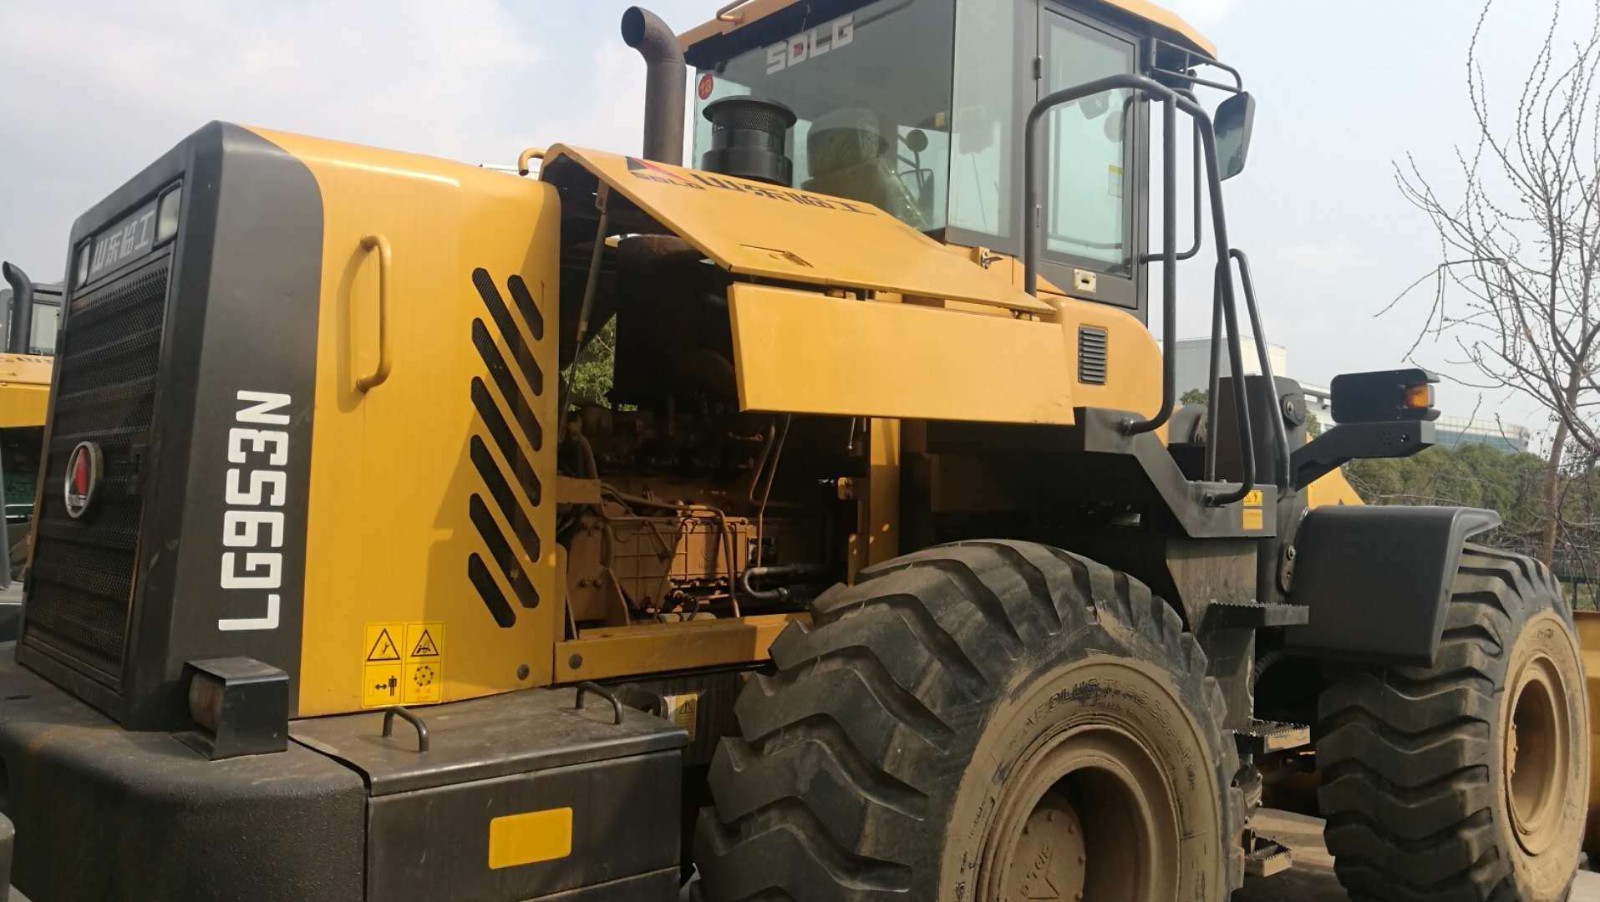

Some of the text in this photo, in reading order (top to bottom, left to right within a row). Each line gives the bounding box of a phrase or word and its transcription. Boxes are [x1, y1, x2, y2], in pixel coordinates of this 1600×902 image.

[766, 15, 854, 75] SDLG
[91, 209, 155, 273] 山东临工
[218, 390, 291, 631] LG953N
